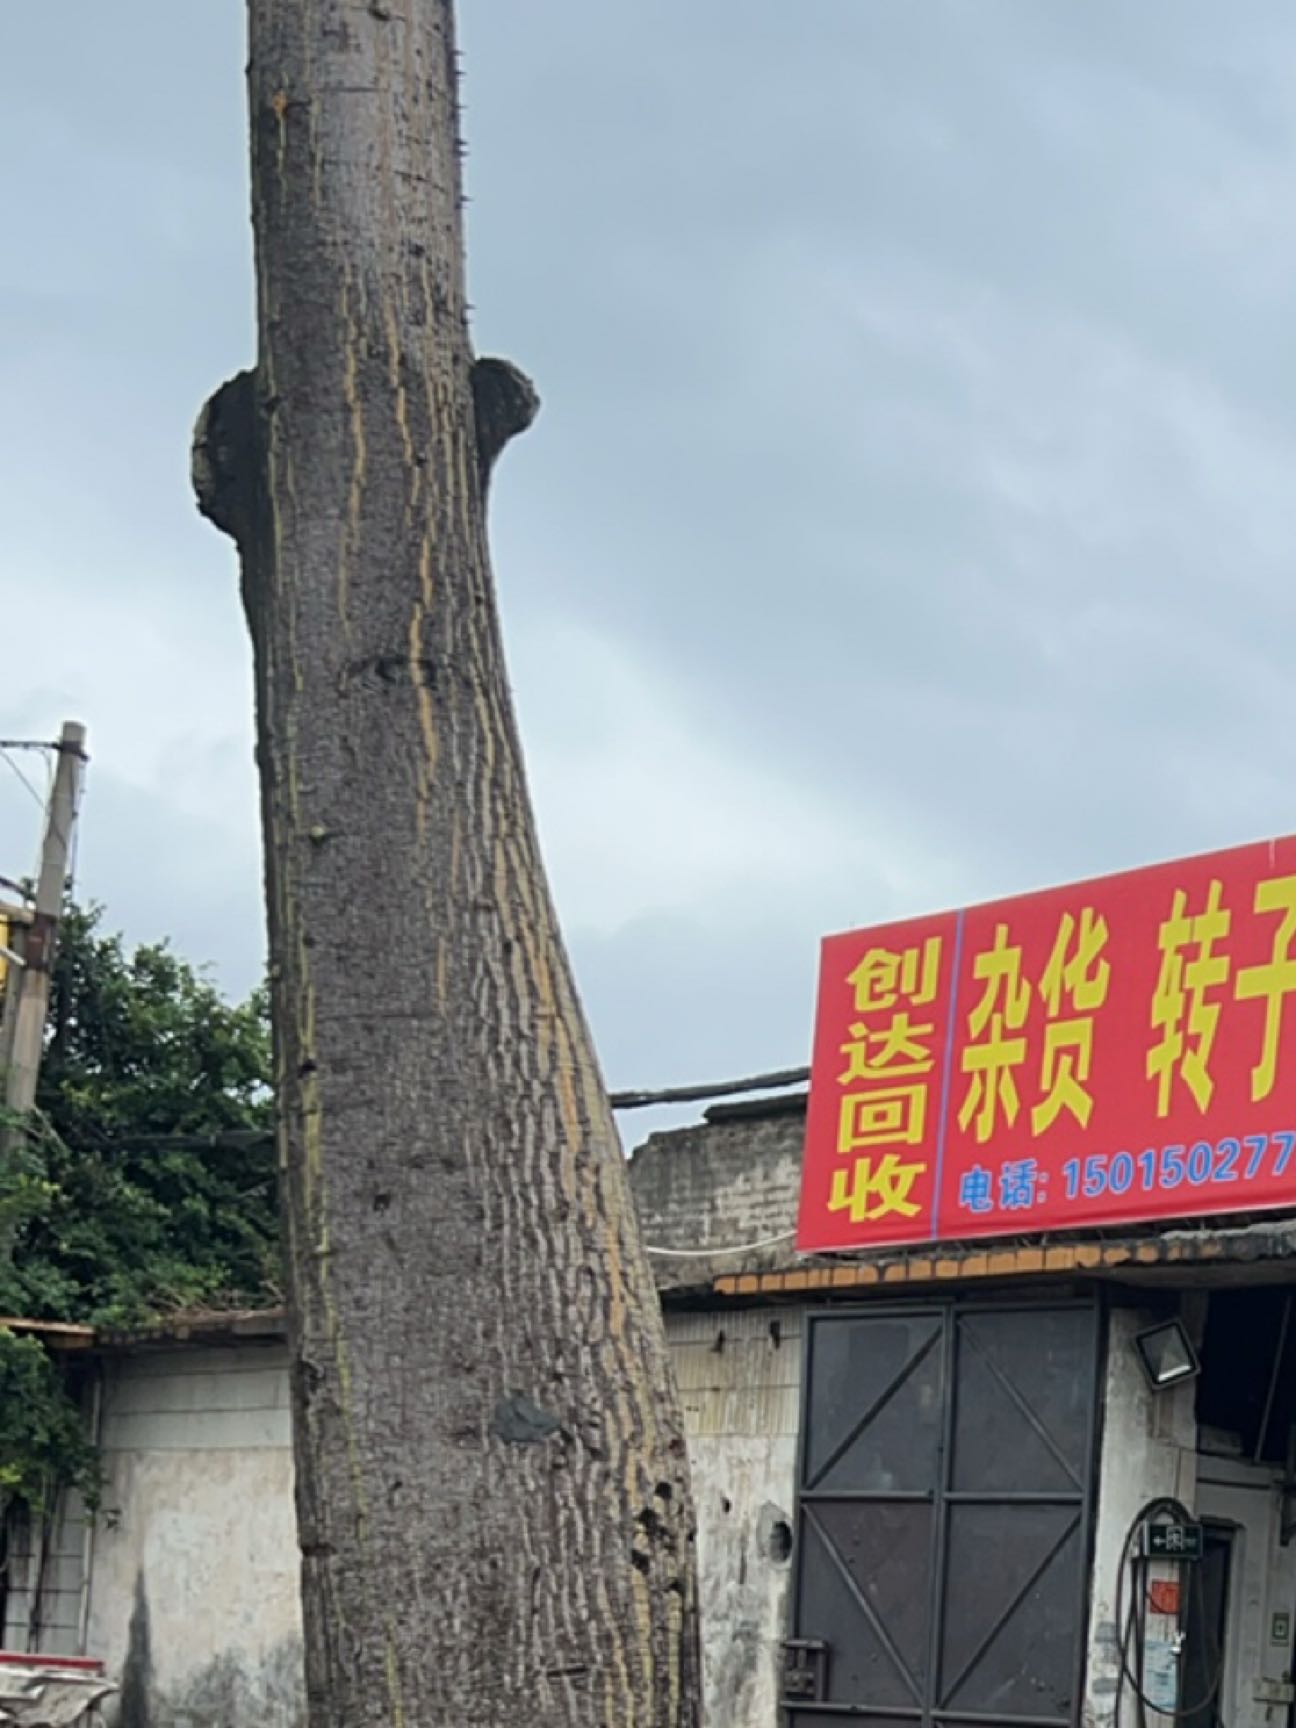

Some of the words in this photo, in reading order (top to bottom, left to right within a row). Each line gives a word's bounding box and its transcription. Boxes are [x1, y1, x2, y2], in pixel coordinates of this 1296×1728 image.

[827, 936, 942, 1223] 创达回收
[957, 907, 1111, 1143] 杂货
